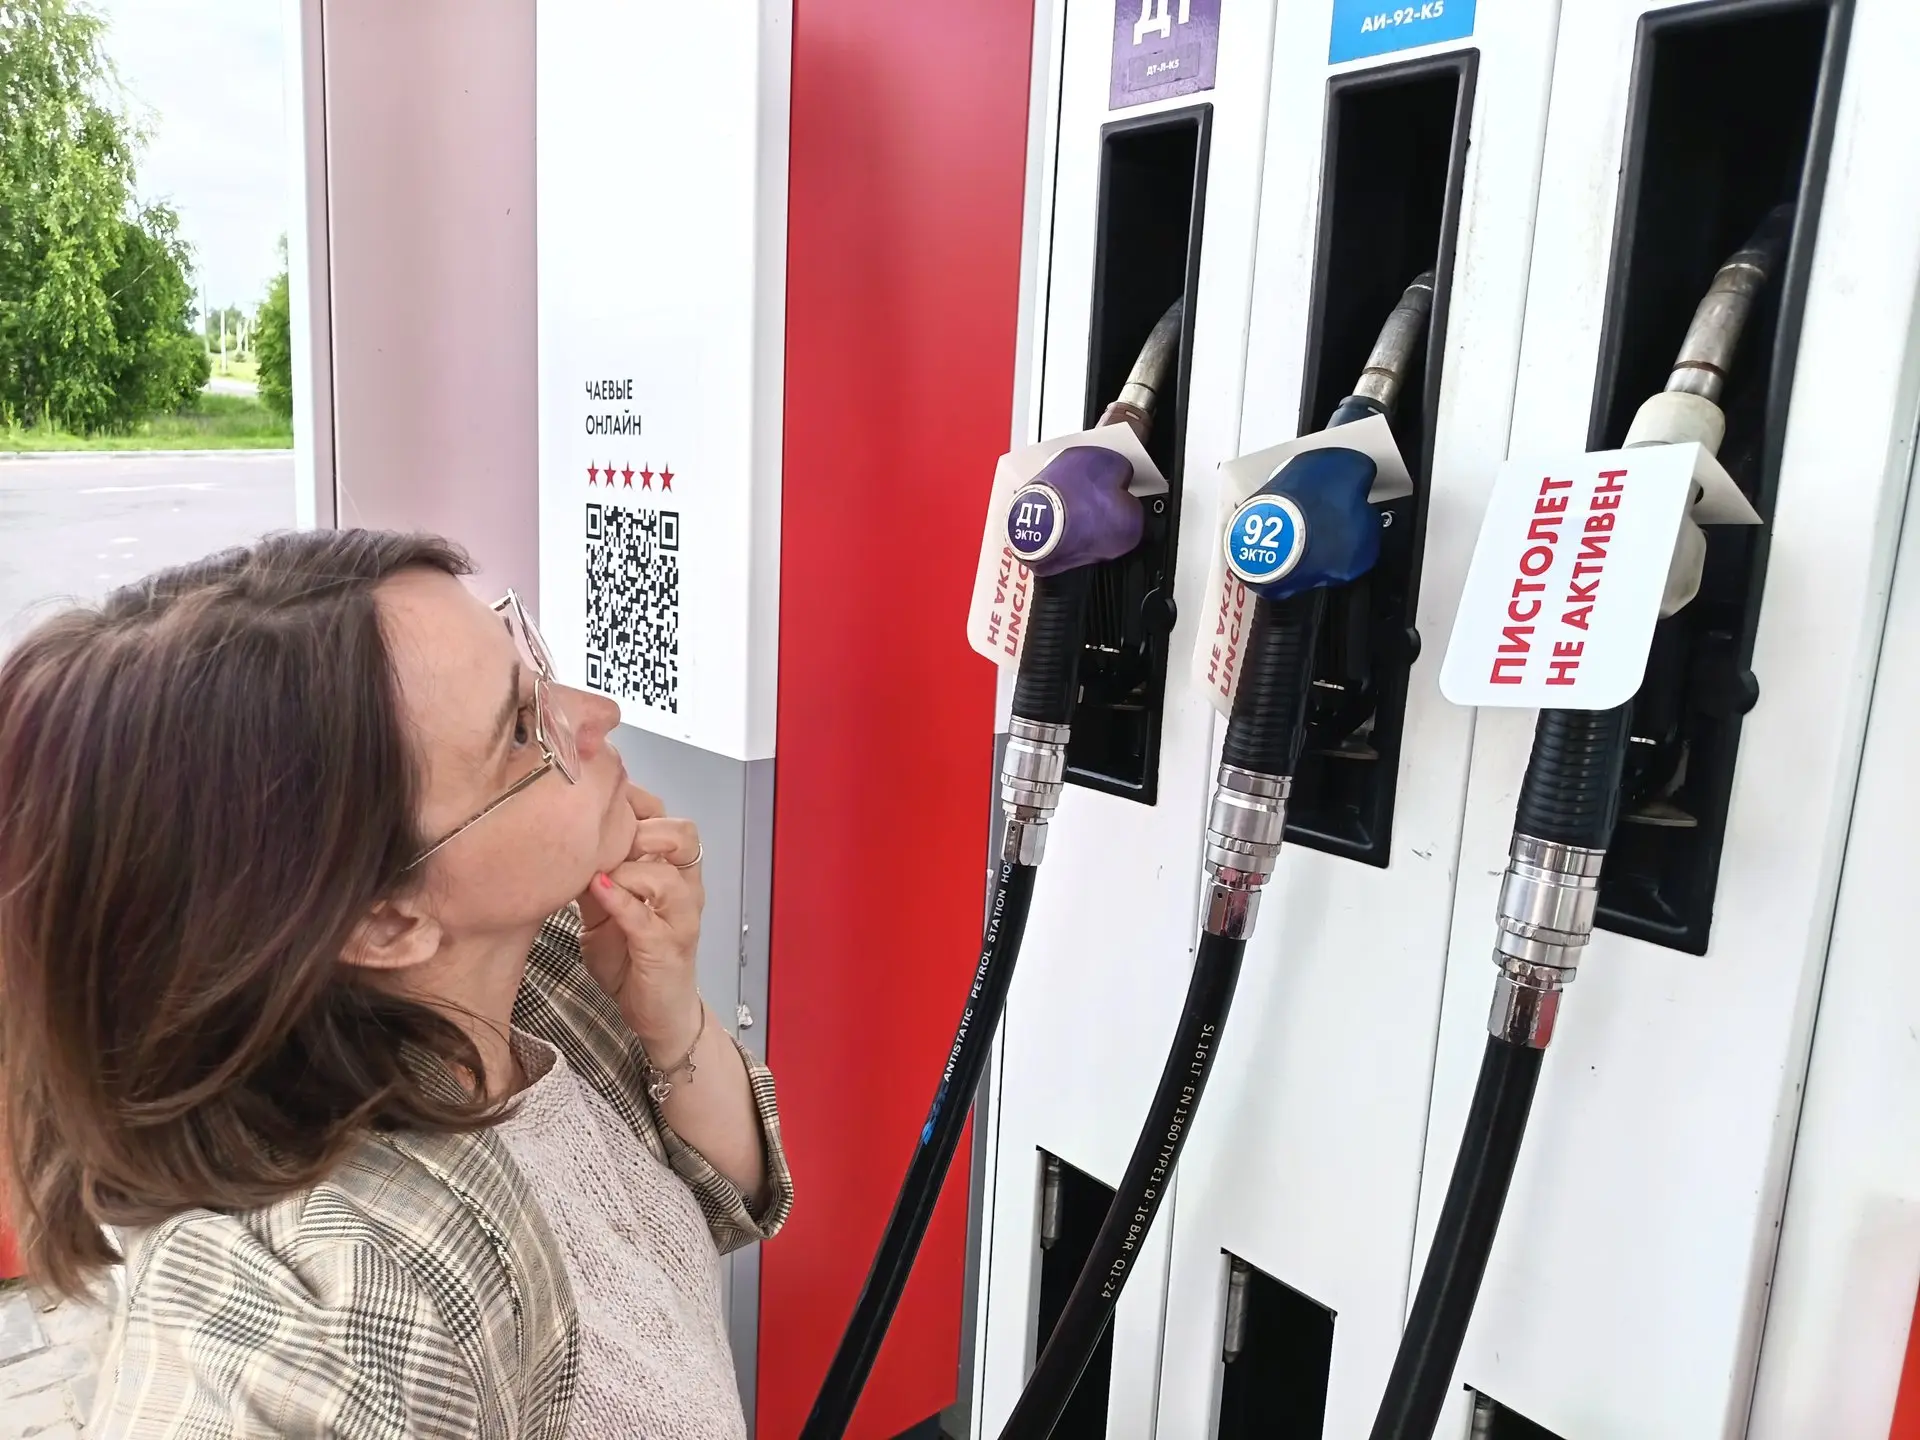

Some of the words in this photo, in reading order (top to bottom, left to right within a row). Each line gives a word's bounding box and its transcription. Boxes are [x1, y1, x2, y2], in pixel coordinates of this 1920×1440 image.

[1360, 1, 1444, 34] АИ-92-К5
[585, 379, 633, 400] ЧАЕВЫЕ
[585, 409, 642, 436] ОНЛАЙН
[1015, 502, 1047, 528] ДТ
[1014, 528, 1042, 543] ЭКТО
[1242, 514, 1284, 549] 92
[1239, 547, 1277, 564] ЭКТО
[1561, 469, 1628, 631] АКТИВЕН
[1489, 476, 1573, 684] ПИСТОЛЕТ
[1545, 641, 1585, 685] НЕ
[943, 1007, 973, 1082] ANTISTATIC
[971, 949, 992, 998] PETROL
[987, 889, 1006, 943] STATION
[1180, 1086, 1195, 1105] EN
[1167, 1107, 1187, 1141] 1360
[1134, 1206, 1149, 1222] 16
[1122, 1224, 1141, 1251] BAR
[1101, 1259, 1126, 1298] Q1-24
